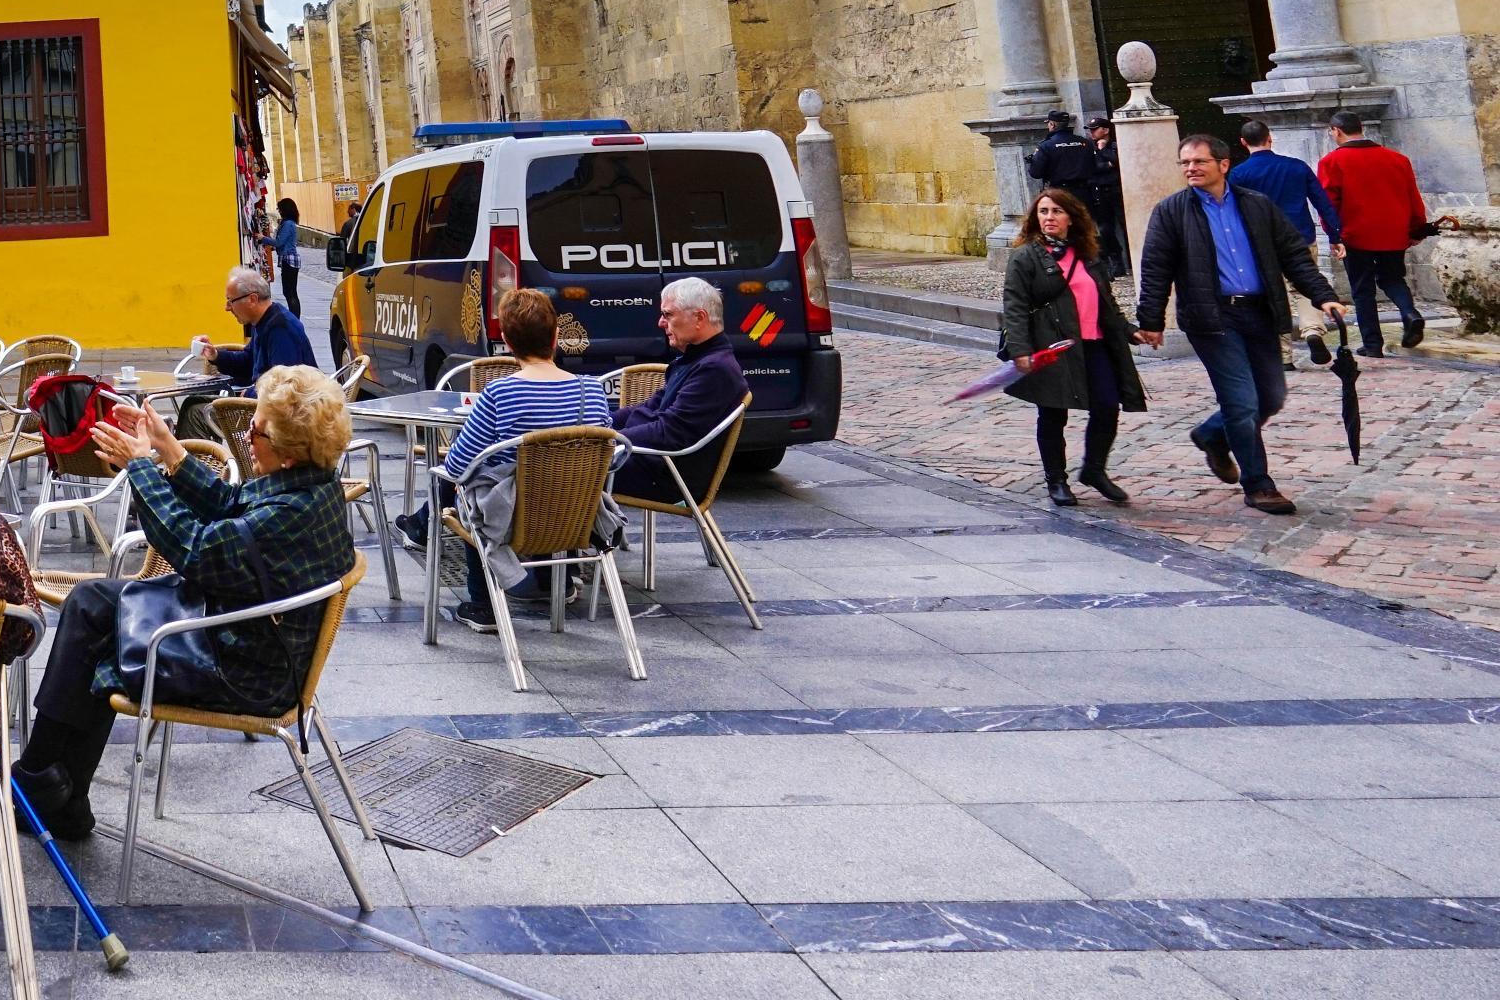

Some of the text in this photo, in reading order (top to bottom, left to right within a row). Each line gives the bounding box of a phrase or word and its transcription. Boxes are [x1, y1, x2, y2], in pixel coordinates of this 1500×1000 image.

[560, 241, 736, 270] POLICI
[590, 297, 653, 306] CITROËN
[375, 296, 418, 341] POLICÍA
